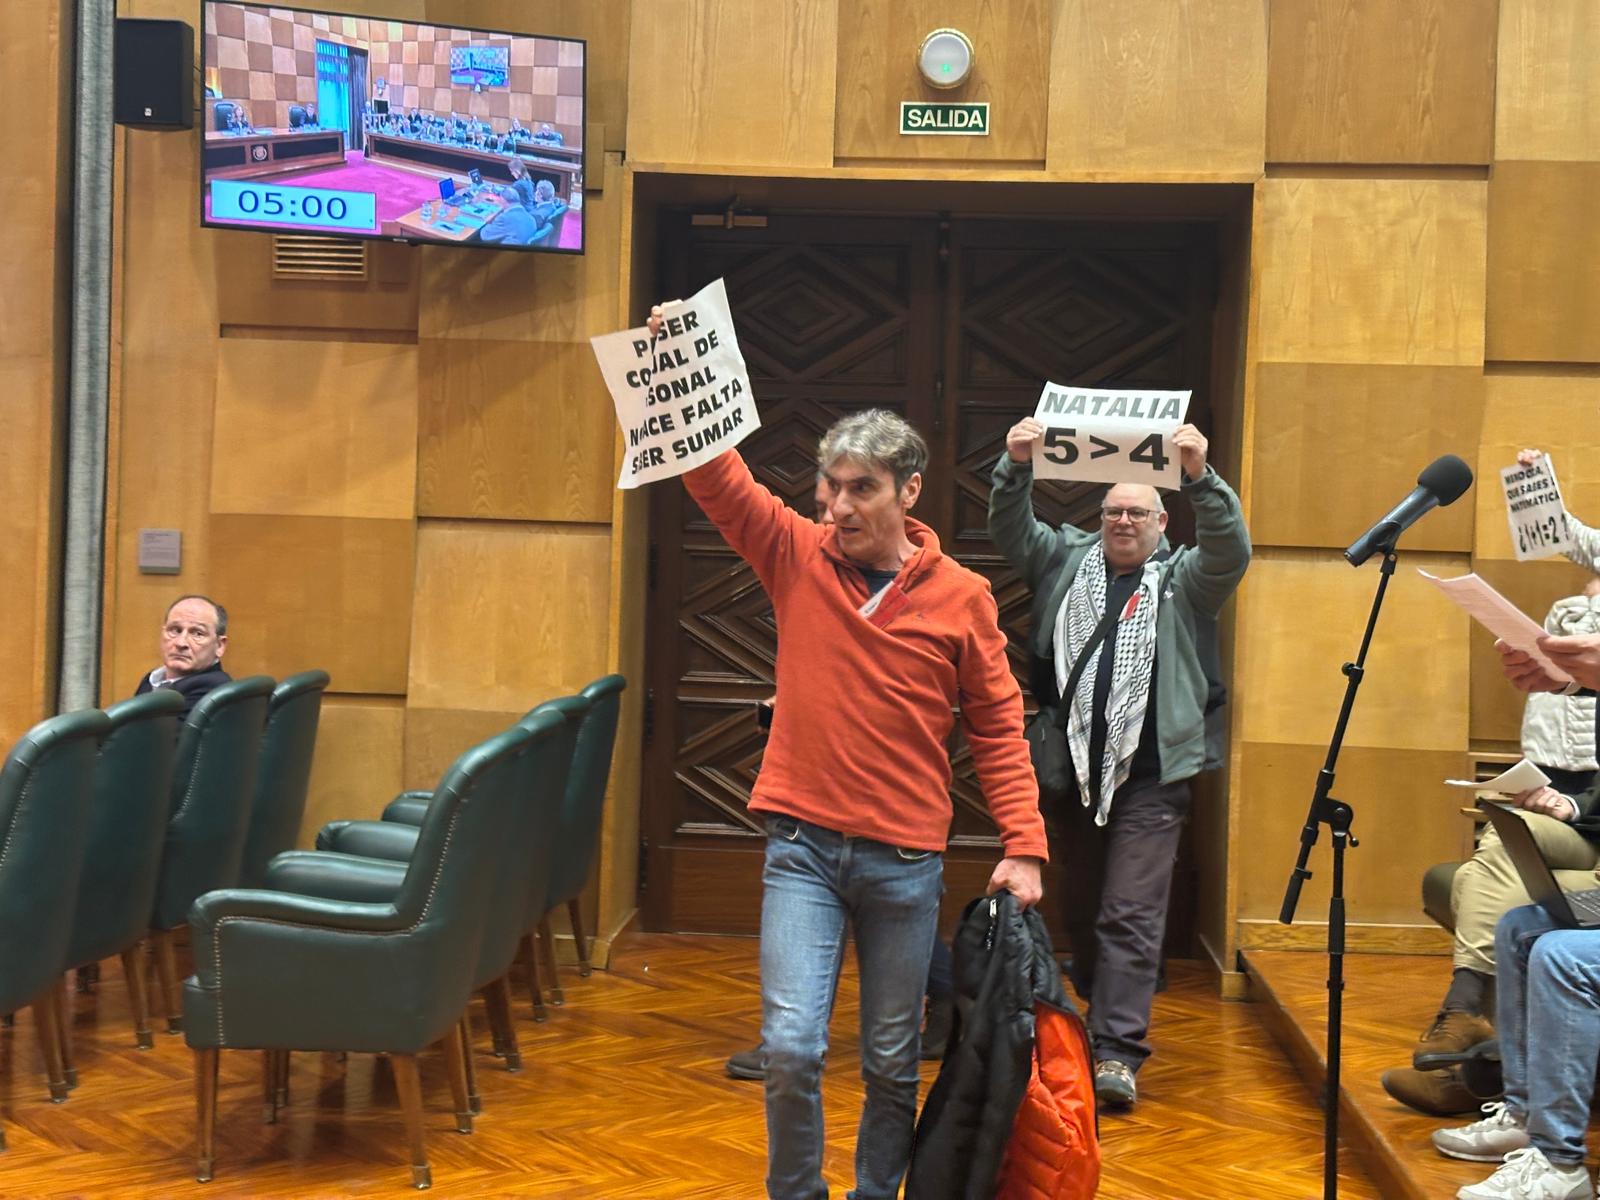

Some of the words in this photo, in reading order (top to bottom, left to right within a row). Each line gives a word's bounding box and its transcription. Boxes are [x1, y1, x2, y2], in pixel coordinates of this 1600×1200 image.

[907, 108, 984, 128] SALIDA
[238, 189, 347, 220] 05:00
[694, 329, 719, 358] DE
[647, 366, 716, 406] SONAL
[681, 377, 743, 426] FALTA
[1043, 391, 1181, 420] NATALIA
[672, 407, 744, 460] SUMAR
